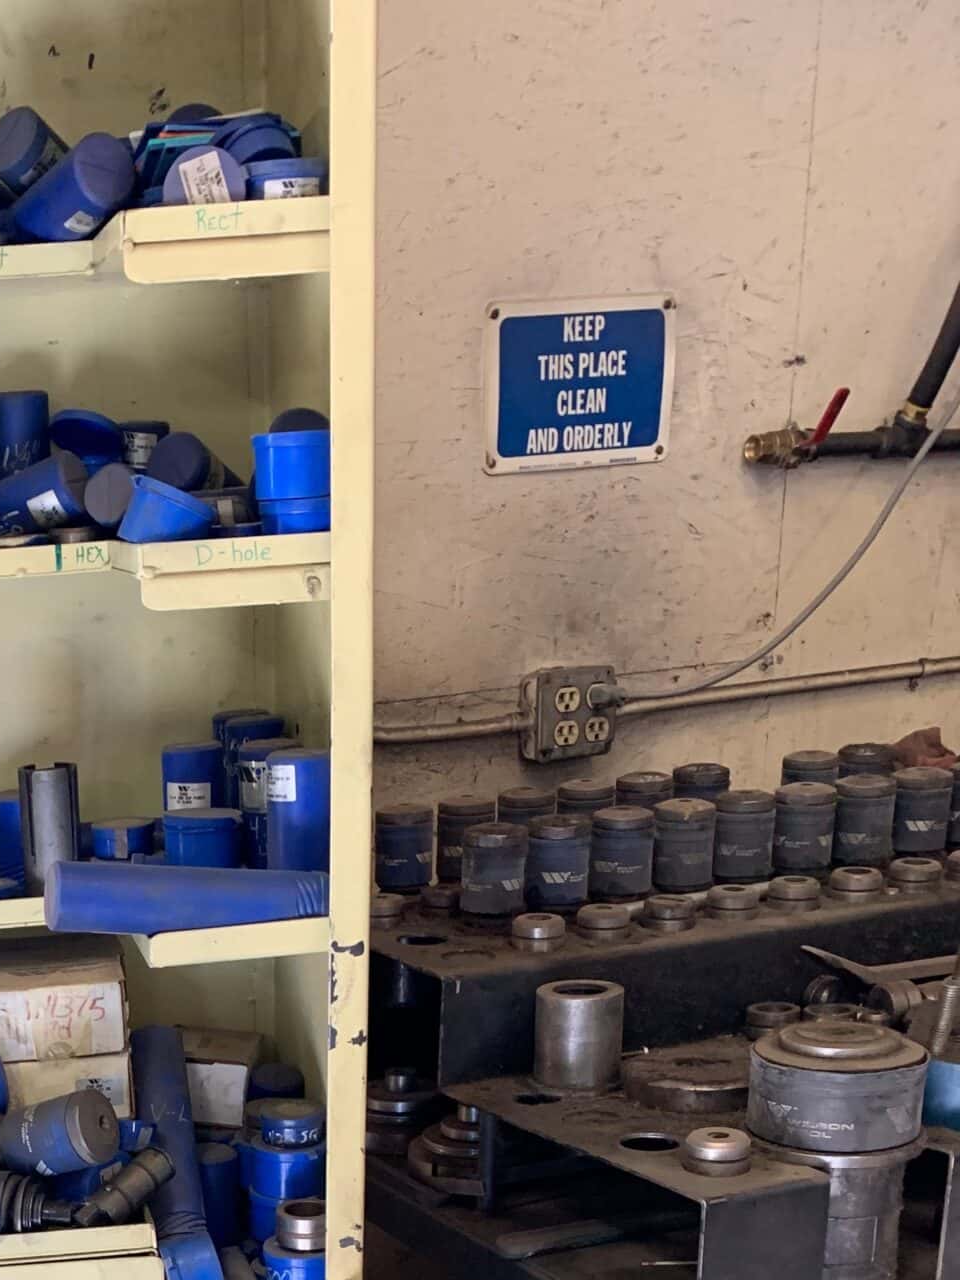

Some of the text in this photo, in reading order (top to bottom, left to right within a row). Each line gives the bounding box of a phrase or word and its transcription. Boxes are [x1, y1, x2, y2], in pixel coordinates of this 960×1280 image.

[563, 315, 606, 343] KEEP
[537, 350, 627, 381] THIS PLACE
[556, 388, 607, 416] CLEAN
[526, 421, 632, 454] AND ORDERLY
[75, 546, 106, 563] HEX
